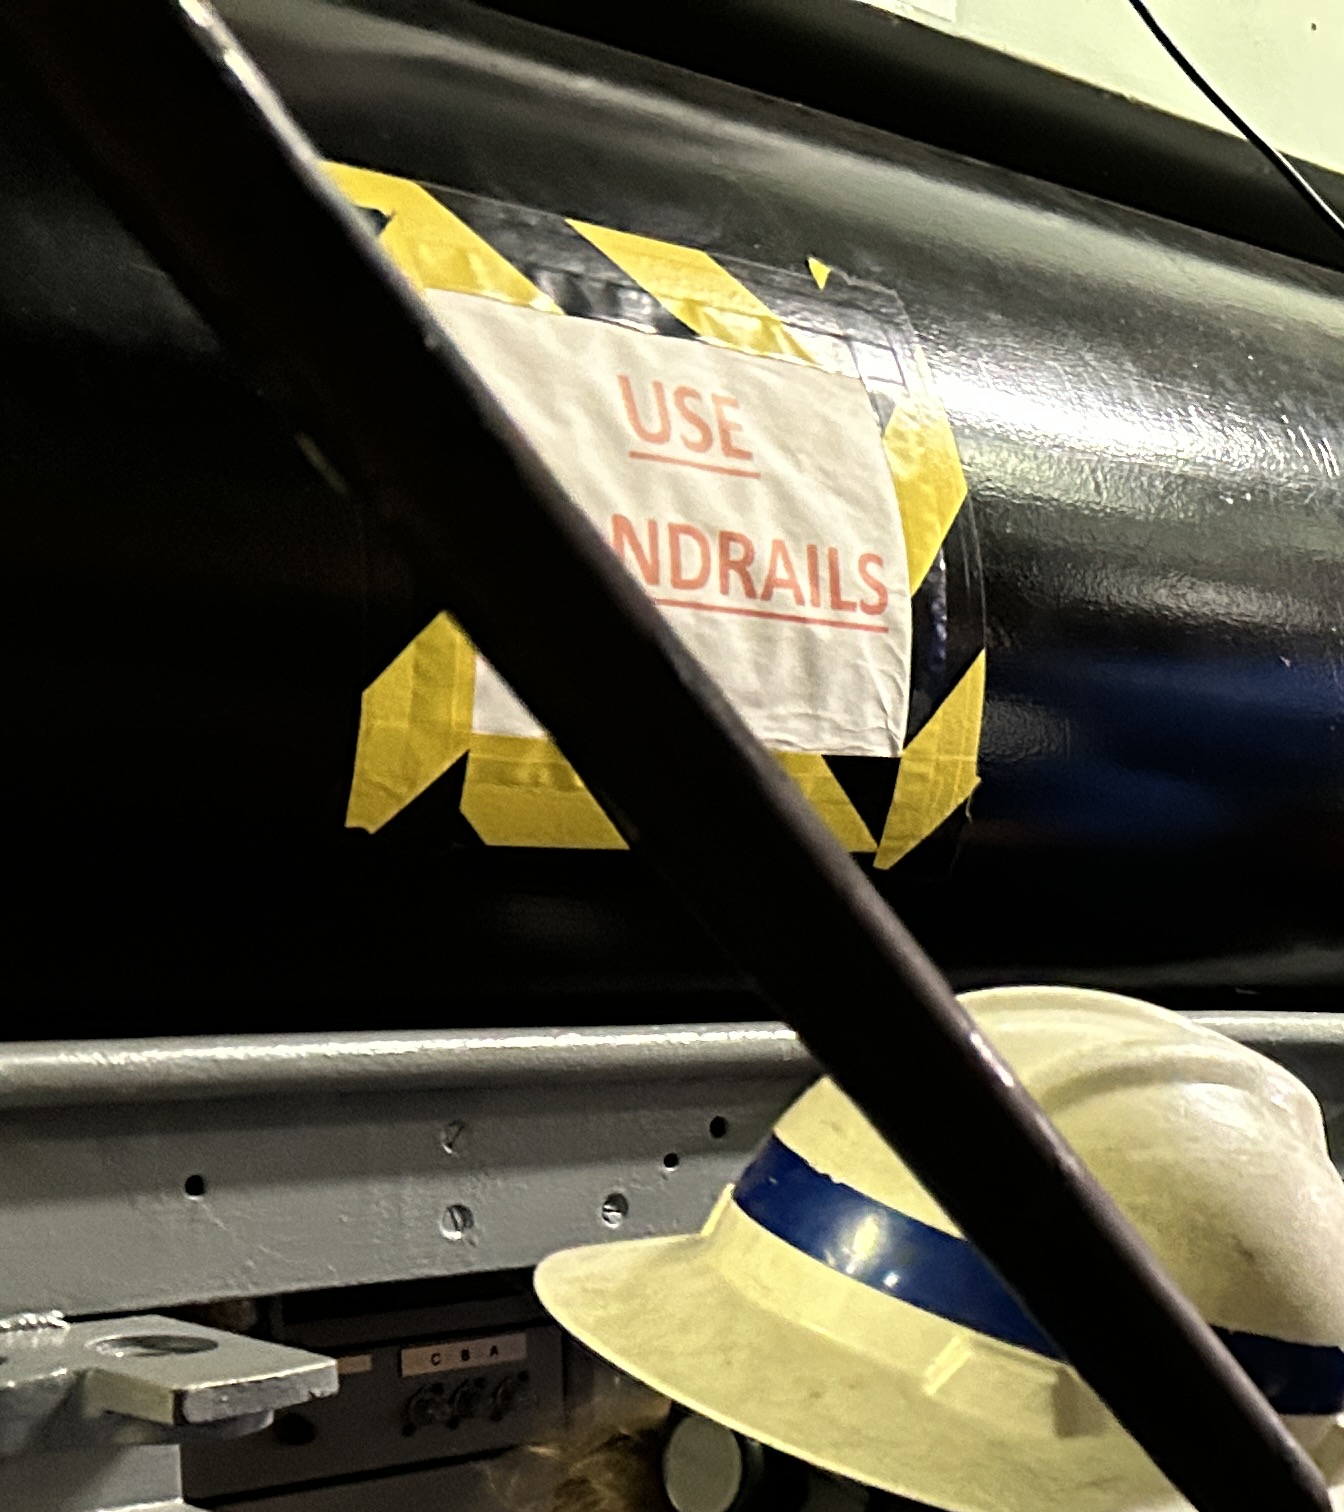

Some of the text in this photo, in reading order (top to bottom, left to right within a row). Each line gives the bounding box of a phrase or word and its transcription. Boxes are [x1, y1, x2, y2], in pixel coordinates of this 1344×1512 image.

[618, 375, 754, 462] USE
[611, 513, 890, 616] NDRAILS
[431, 1345, 499, 1366] C B A
